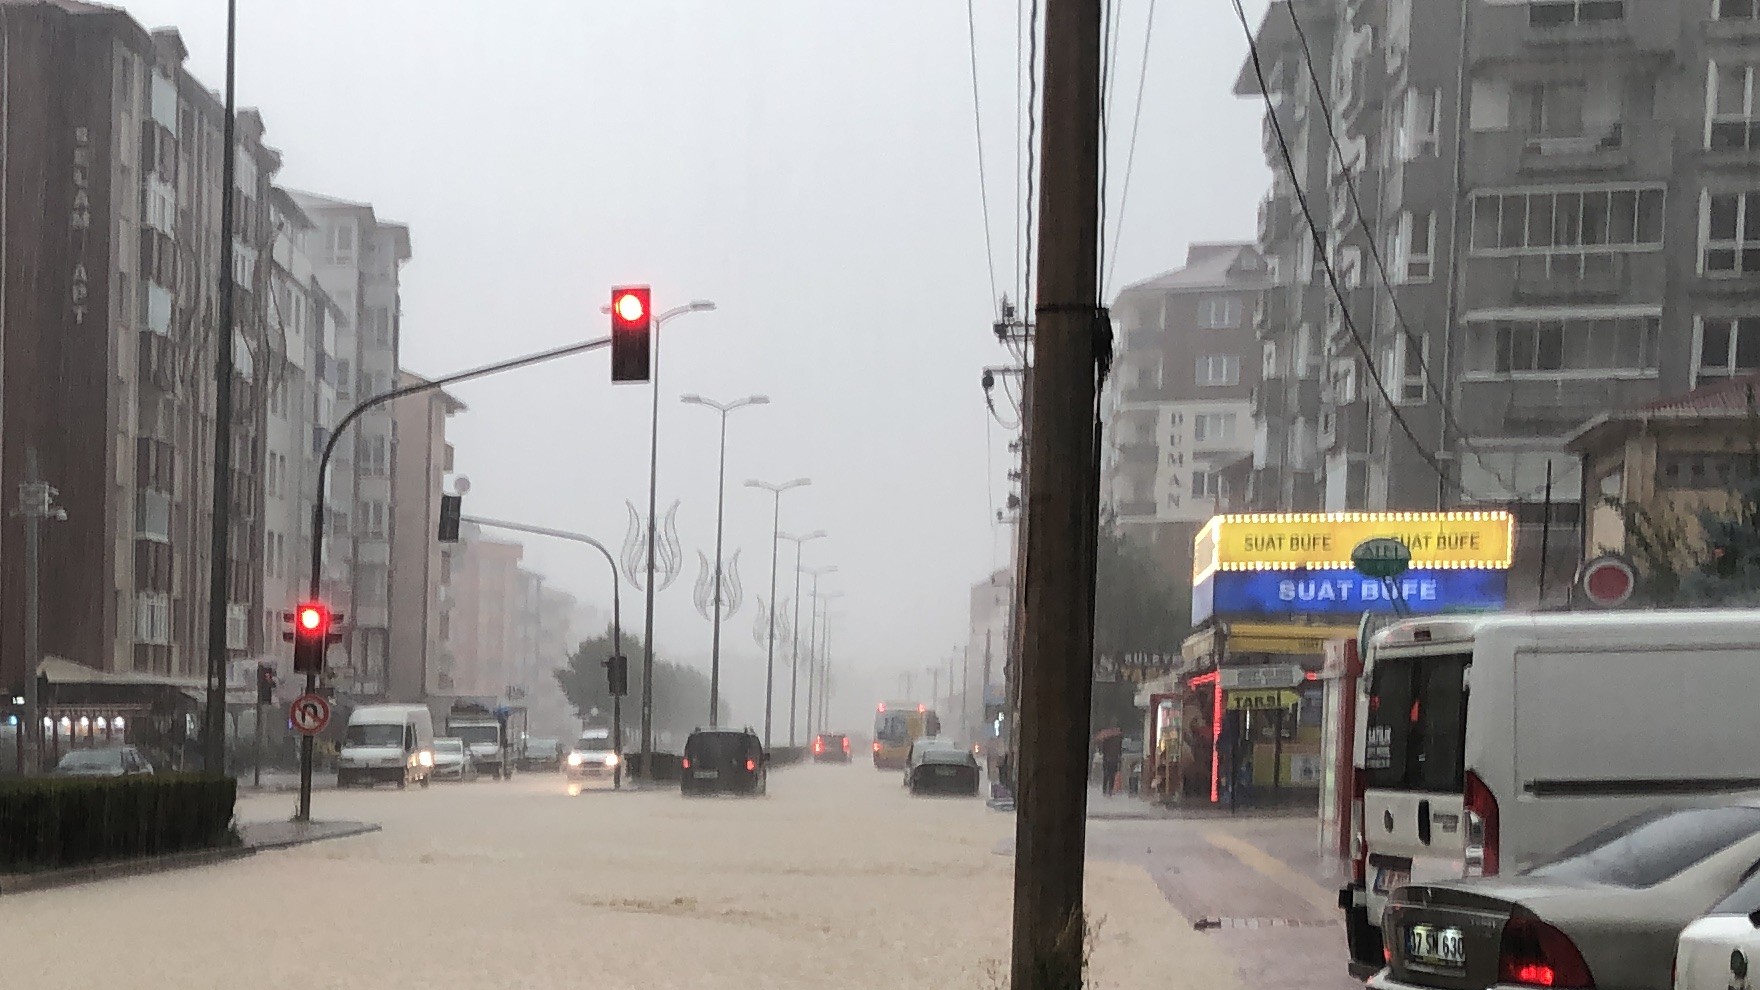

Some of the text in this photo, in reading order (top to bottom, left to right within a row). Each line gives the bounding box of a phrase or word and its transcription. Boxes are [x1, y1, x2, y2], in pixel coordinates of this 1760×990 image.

[1245, 533, 1285, 551] SUAT
[1390, 533, 1432, 551] UAT
[1279, 579, 1353, 600] SUAT
